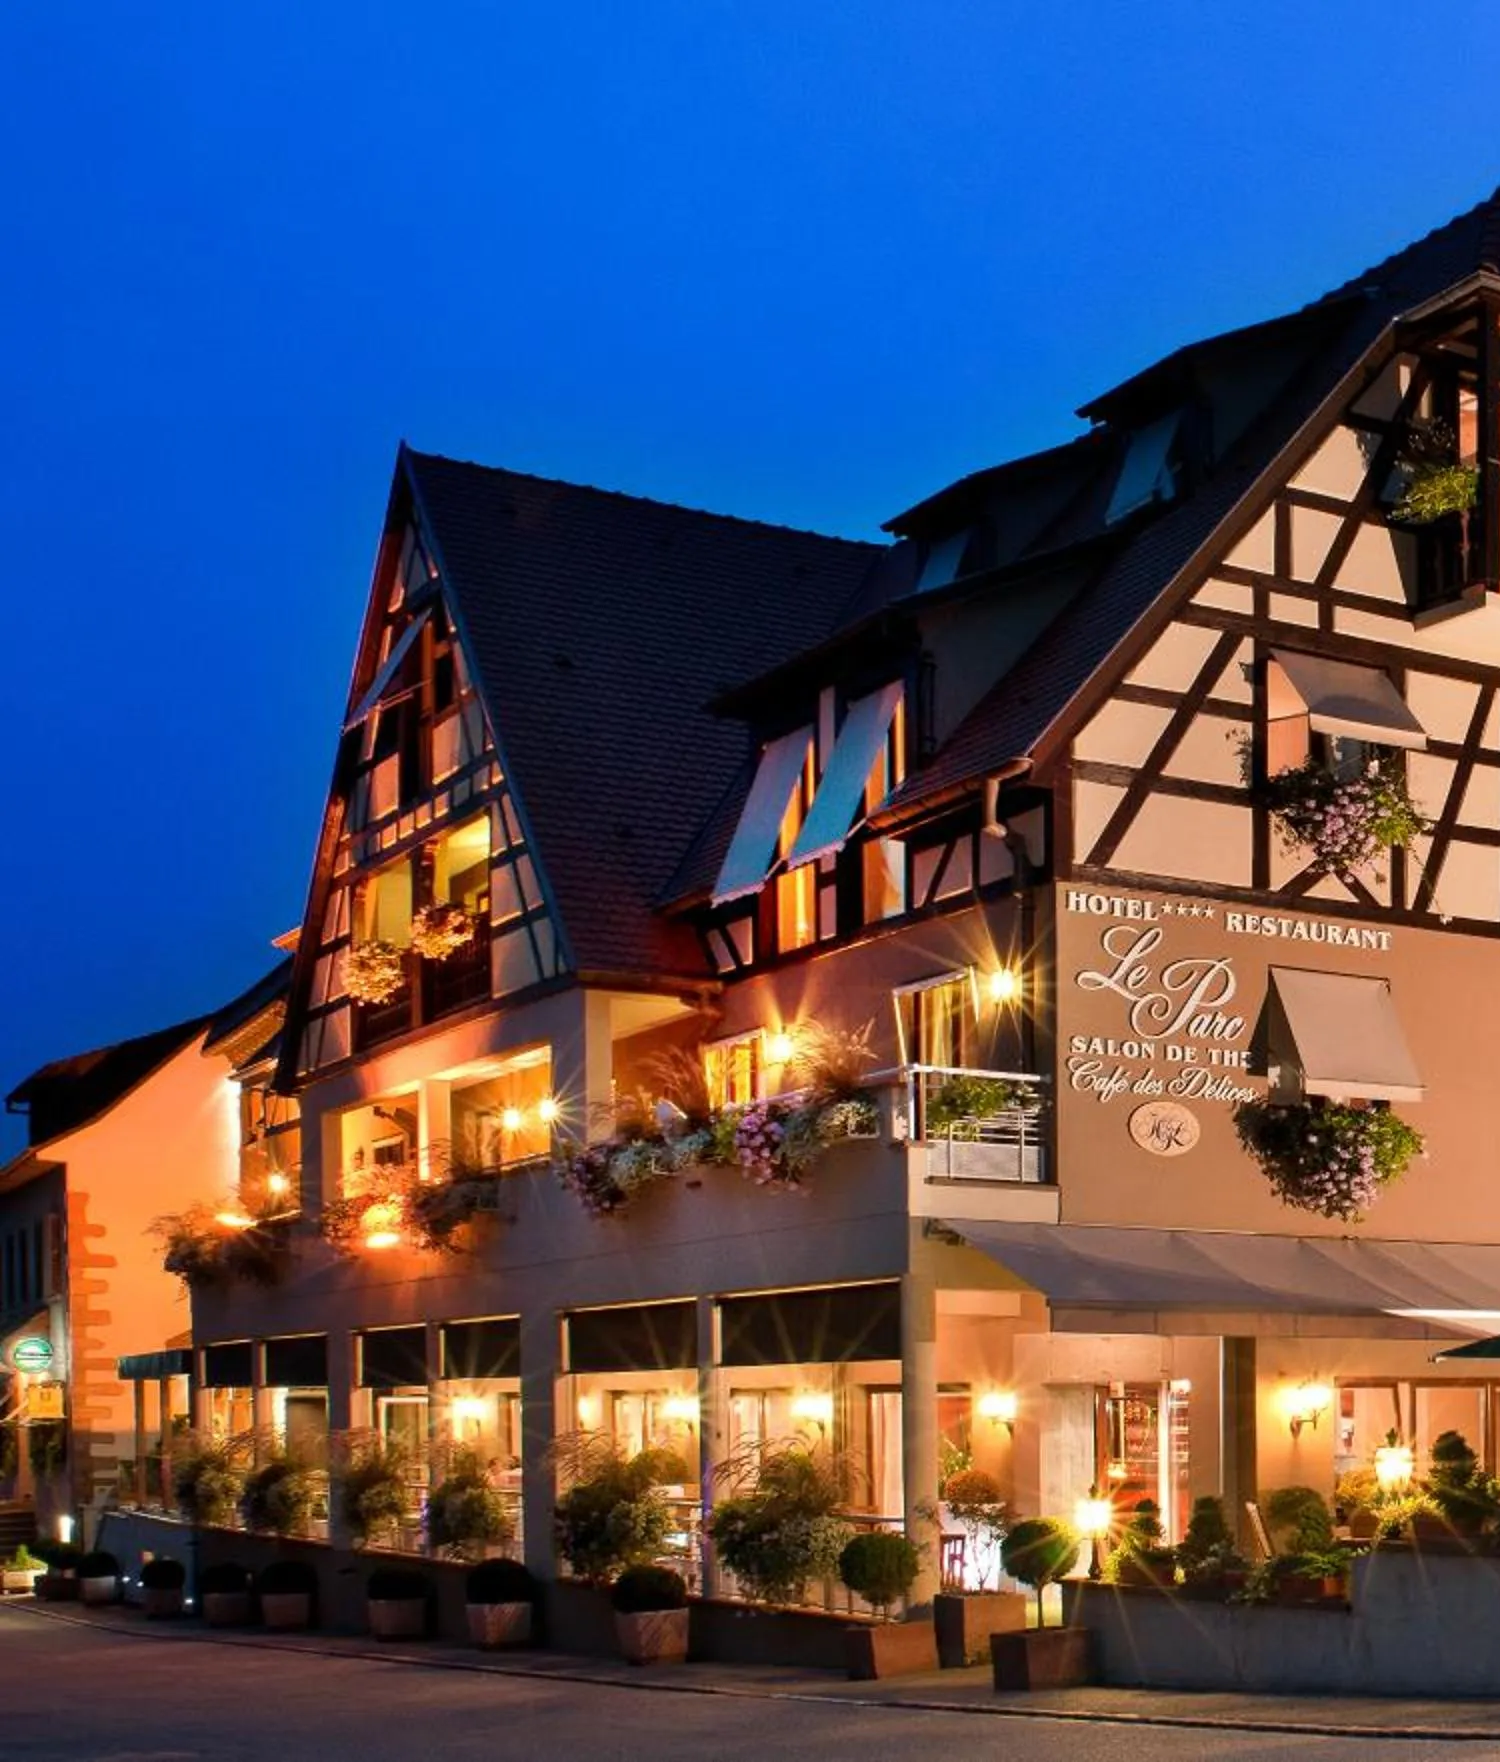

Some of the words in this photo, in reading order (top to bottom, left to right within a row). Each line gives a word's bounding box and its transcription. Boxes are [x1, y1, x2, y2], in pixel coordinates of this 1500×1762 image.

[1066, 891, 1159, 921] HOTEL
[1225, 912, 1393, 950] RESTAURANT
[1076, 925, 1163, 1001] Le
[1130, 957, 1247, 1041] Parc
[1071, 1036, 1155, 1060] SALON
[1166, 1045, 1197, 1062] DE
[1206, 1049, 1253, 1068] THE
[1067, 1056, 1129, 1103] Café
[1132, 1068, 1164, 1096] des
